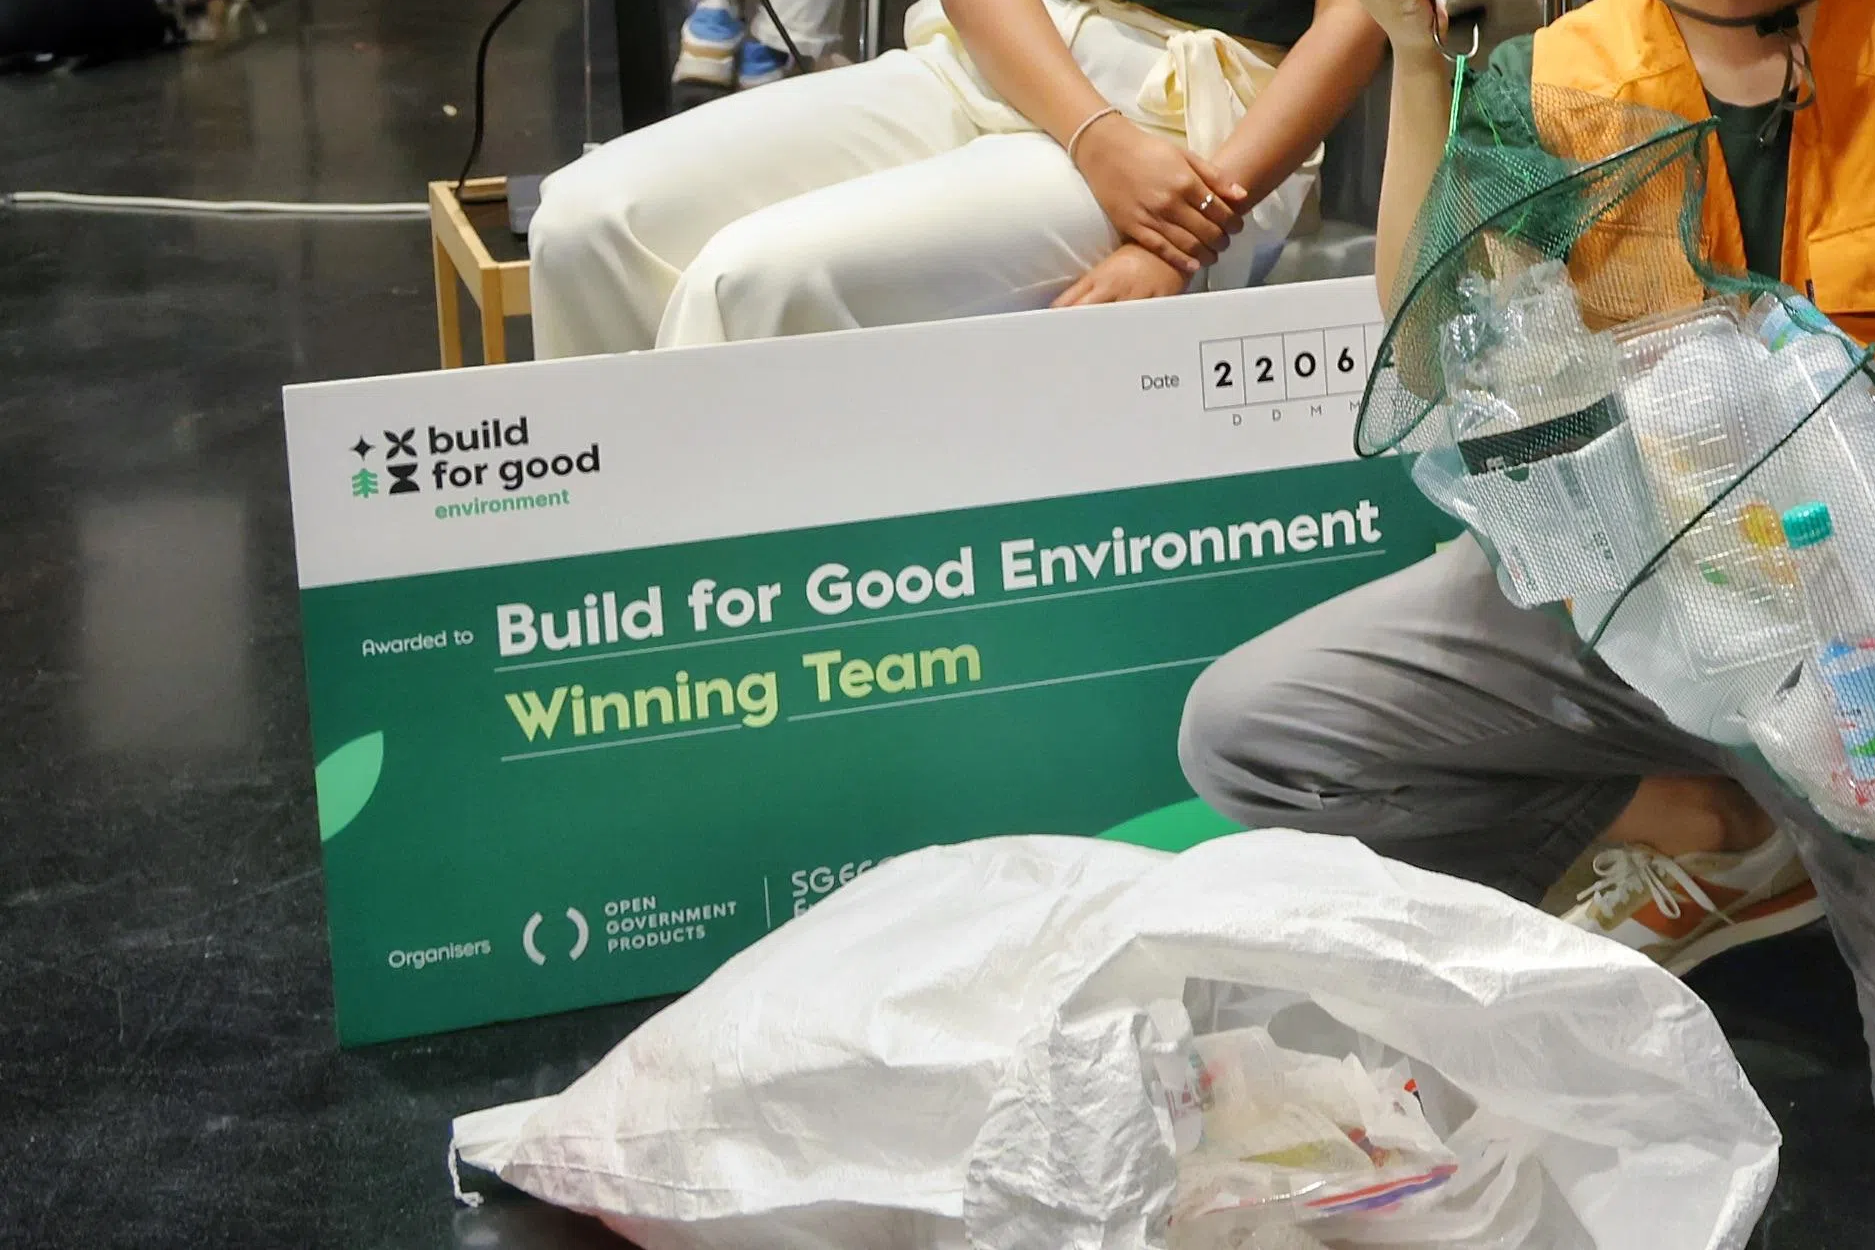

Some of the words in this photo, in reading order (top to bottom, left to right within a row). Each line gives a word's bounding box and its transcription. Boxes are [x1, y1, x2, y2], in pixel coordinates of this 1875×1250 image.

[1141, 372, 1180, 391] Date
[428, 416, 529, 455] build
[432, 460, 488, 490] for
[499, 443, 601, 491] good
[434, 489, 570, 519] environment
[362, 631, 448, 657] Awarded
[453, 630, 474, 646] to
[496, 585, 664, 657] Build
[688, 578, 781, 632] for
[805, 546, 975, 616] Good
[1000, 499, 1382, 592] Environment
[504, 669, 779, 743] Winning
[802, 644, 981, 703] Team
[604, 895, 656, 917] OPEN
[605, 901, 737, 935] GOVERNMENT
[388, 939, 491, 970] Organisers
[607, 924, 706, 953] PRODUCTS
